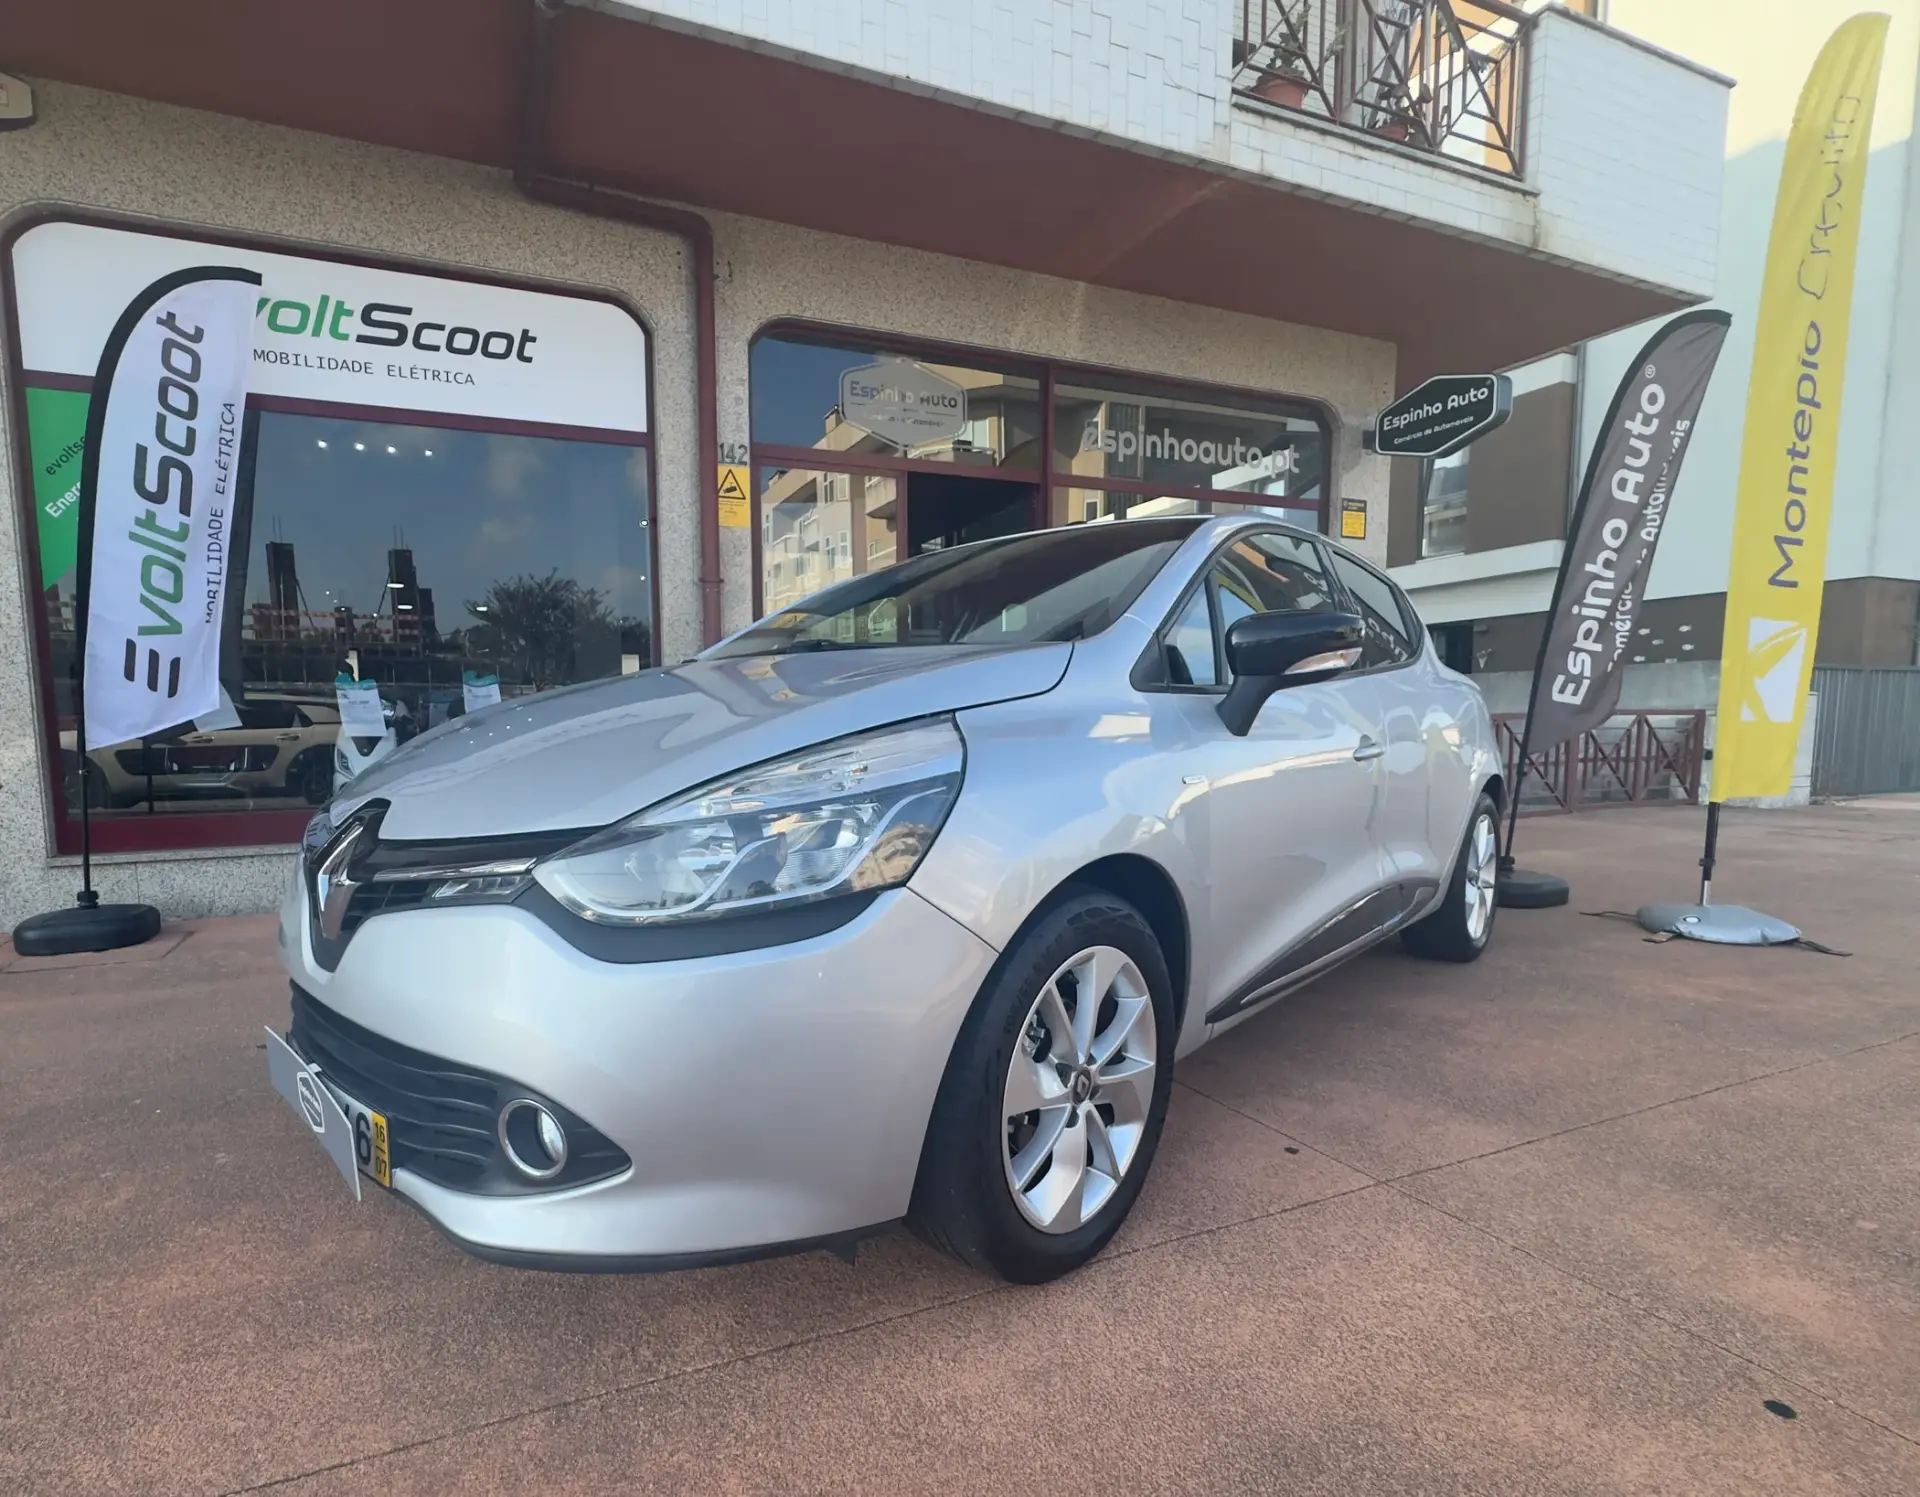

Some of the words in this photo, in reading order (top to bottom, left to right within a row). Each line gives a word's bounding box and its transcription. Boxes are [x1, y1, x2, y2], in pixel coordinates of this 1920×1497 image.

[256, 294, 537, 363] oltScoot
[253, 349, 374, 375] MOBILIDADE
[386, 364, 476, 385] ELÉTRICA
[1383, 402, 1443, 431] Espinho
[1447, 387, 1489, 410] Auto
[214, 403, 236, 495] ELÉTRICA
[719, 442, 748, 466] 142
[1083, 427, 1300, 479] espinhoauto.pt
[1768, 320, 1822, 588] Montepio
[124, 310, 205, 698] EvoltScoot
[1552, 518, 1628, 705] Espinho
[374, 1122, 386, 1143] 16
[375, 1156, 388, 1178] 07
